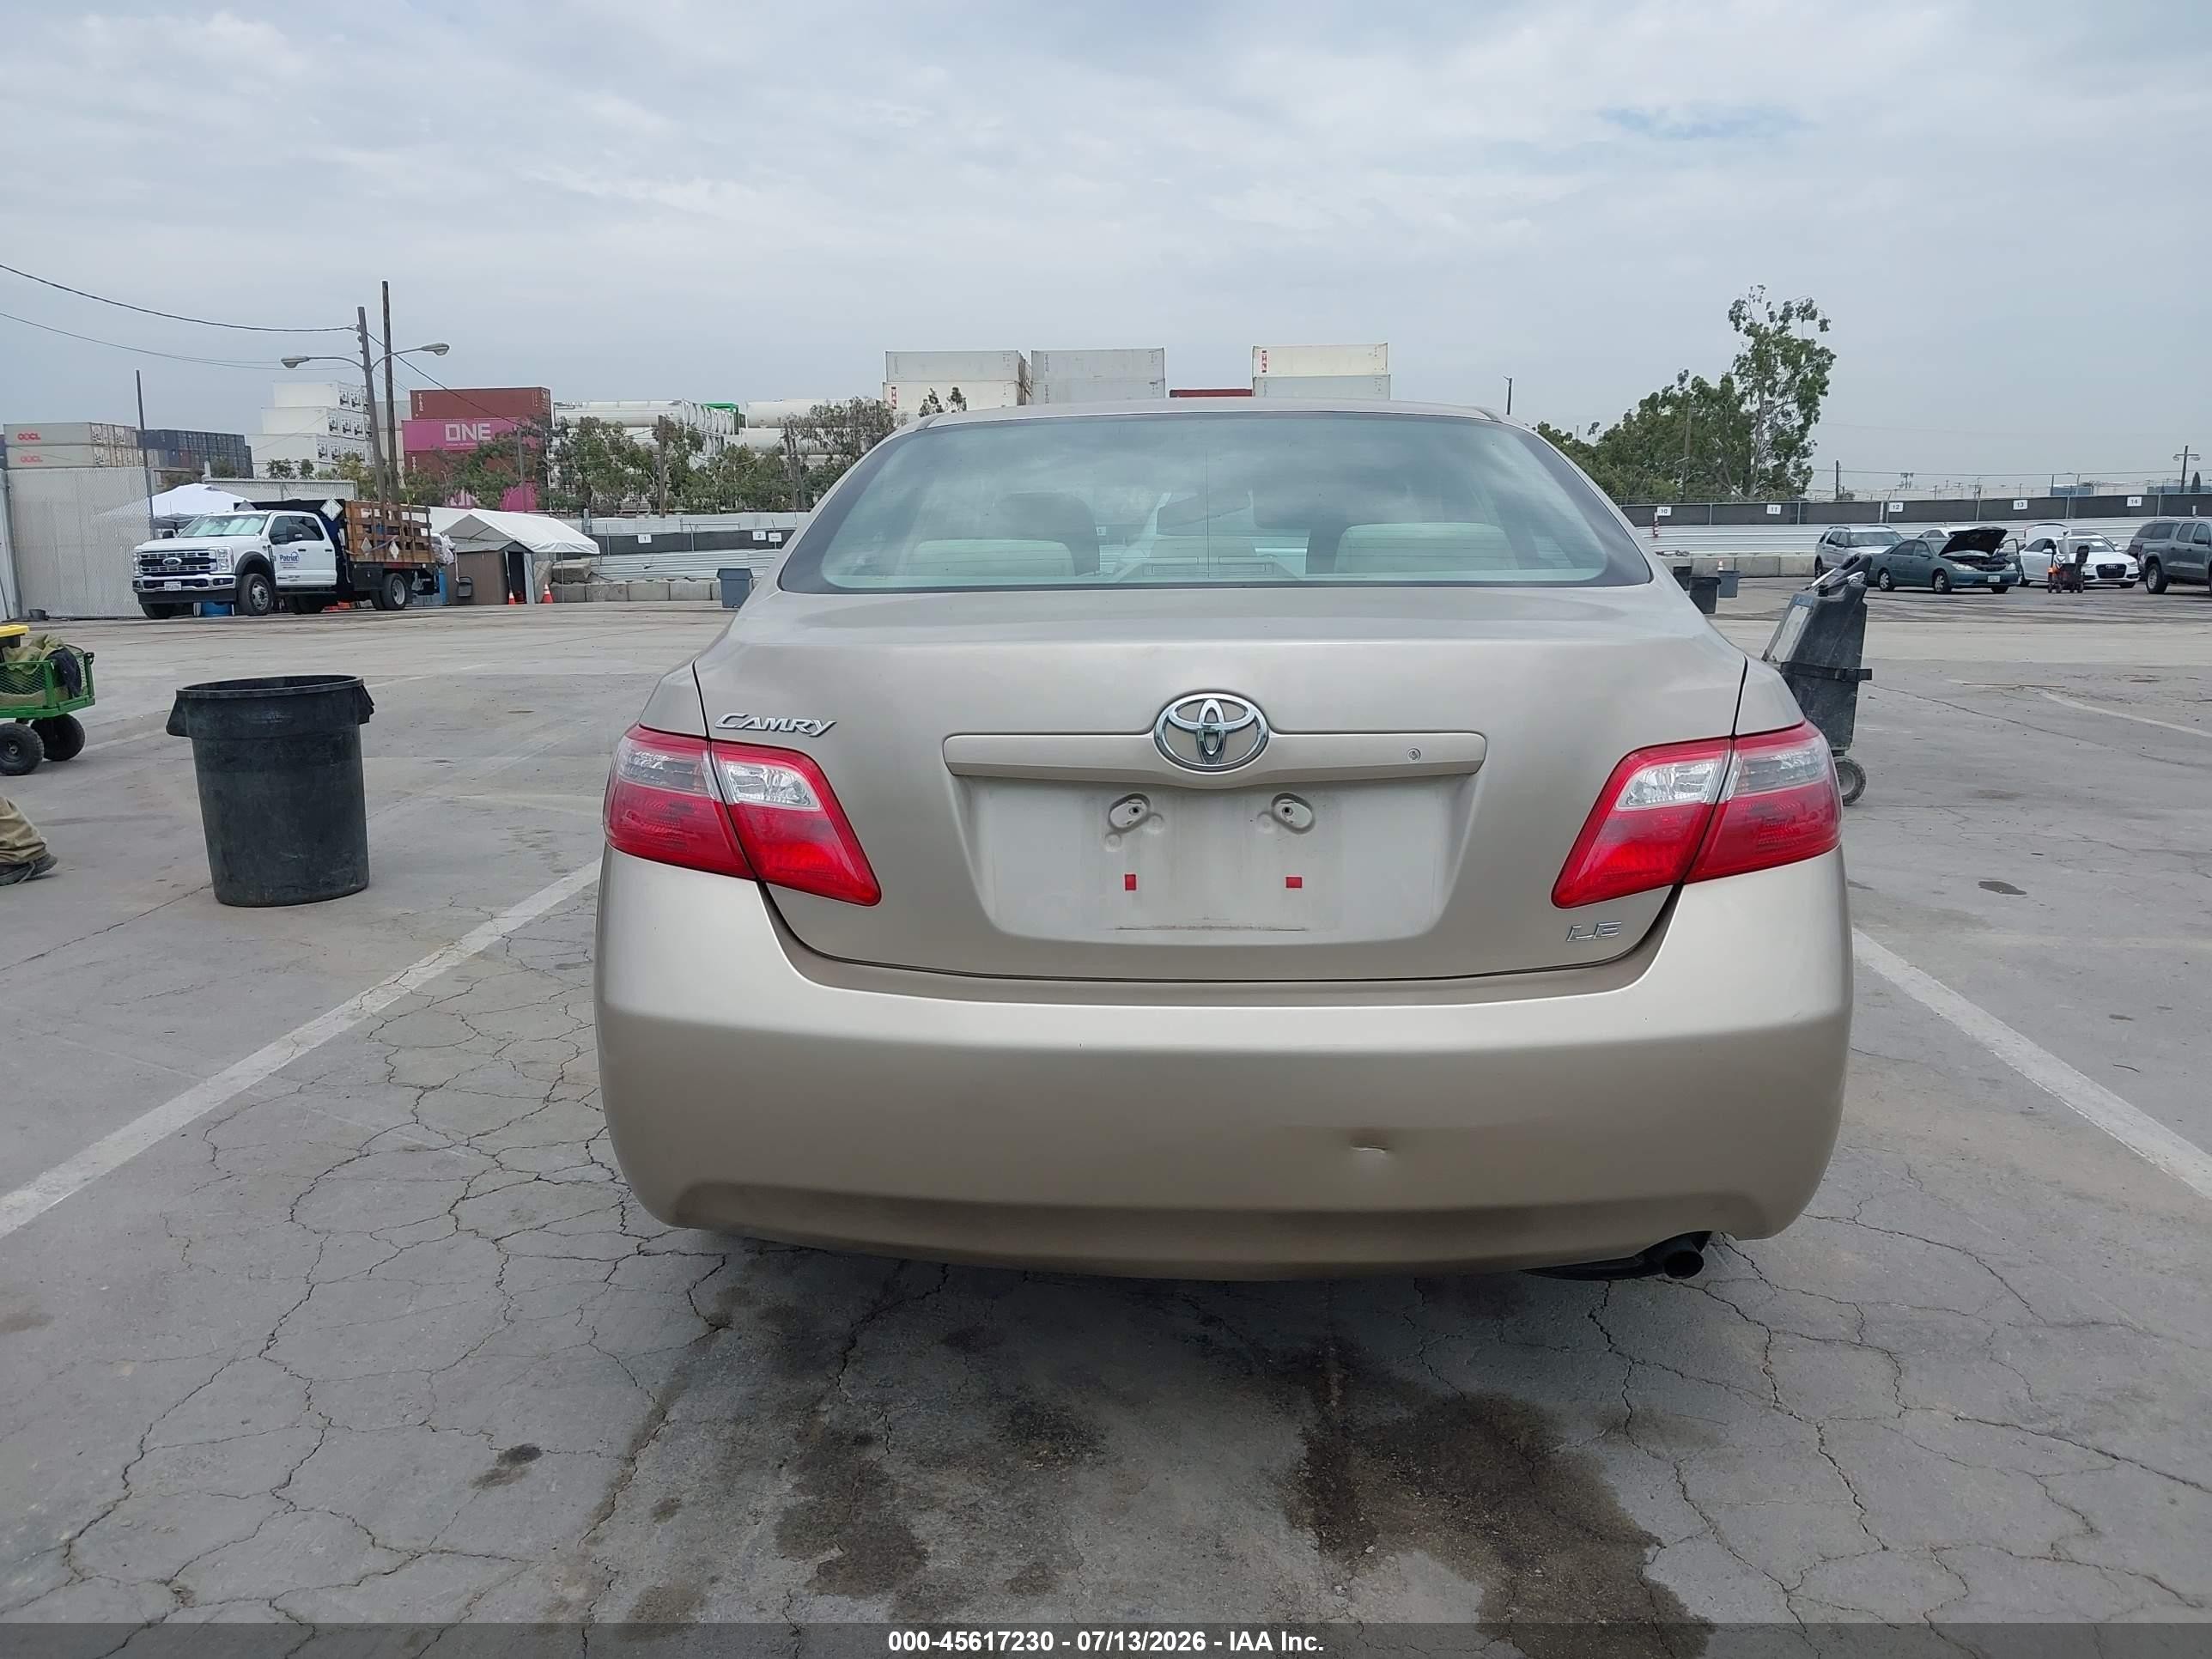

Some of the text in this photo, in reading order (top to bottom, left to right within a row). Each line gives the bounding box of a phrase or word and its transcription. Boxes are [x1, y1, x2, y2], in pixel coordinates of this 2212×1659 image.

[445, 423, 491, 441] ONE
[714, 712, 837, 738] CAMRY
[1566, 921, 1622, 942] LE
